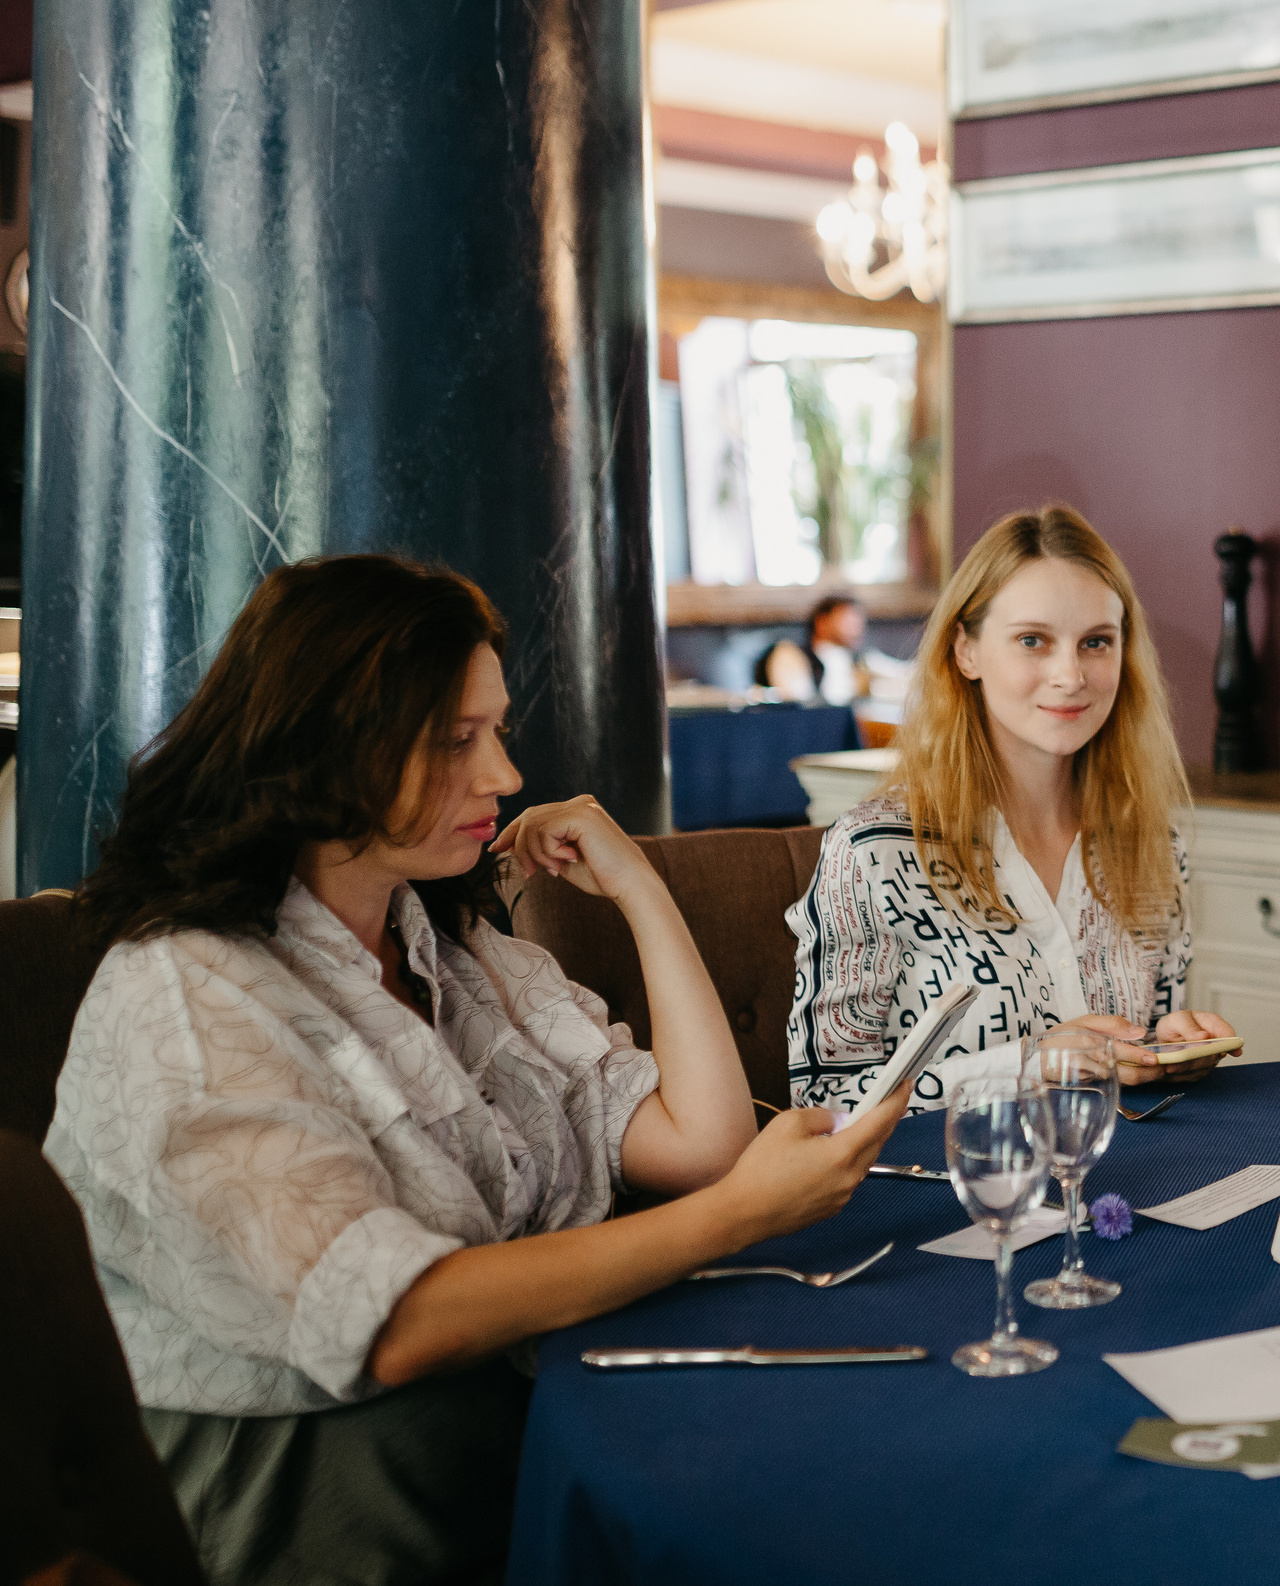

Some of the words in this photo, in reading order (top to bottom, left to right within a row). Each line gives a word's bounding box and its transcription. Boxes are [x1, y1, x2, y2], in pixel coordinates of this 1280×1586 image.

[832, 890, 840, 903] Los
[843, 881, 851, 895] Los
[834, 904, 848, 936] Angeles
[845, 896, 858, 929] Angeles
[858, 900, 873, 935] TOMMY
[823, 911, 835, 943] TOMMY
[839, 949, 849, 967] New
[854, 942, 864, 960] New
[852, 963, 860, 983] York
